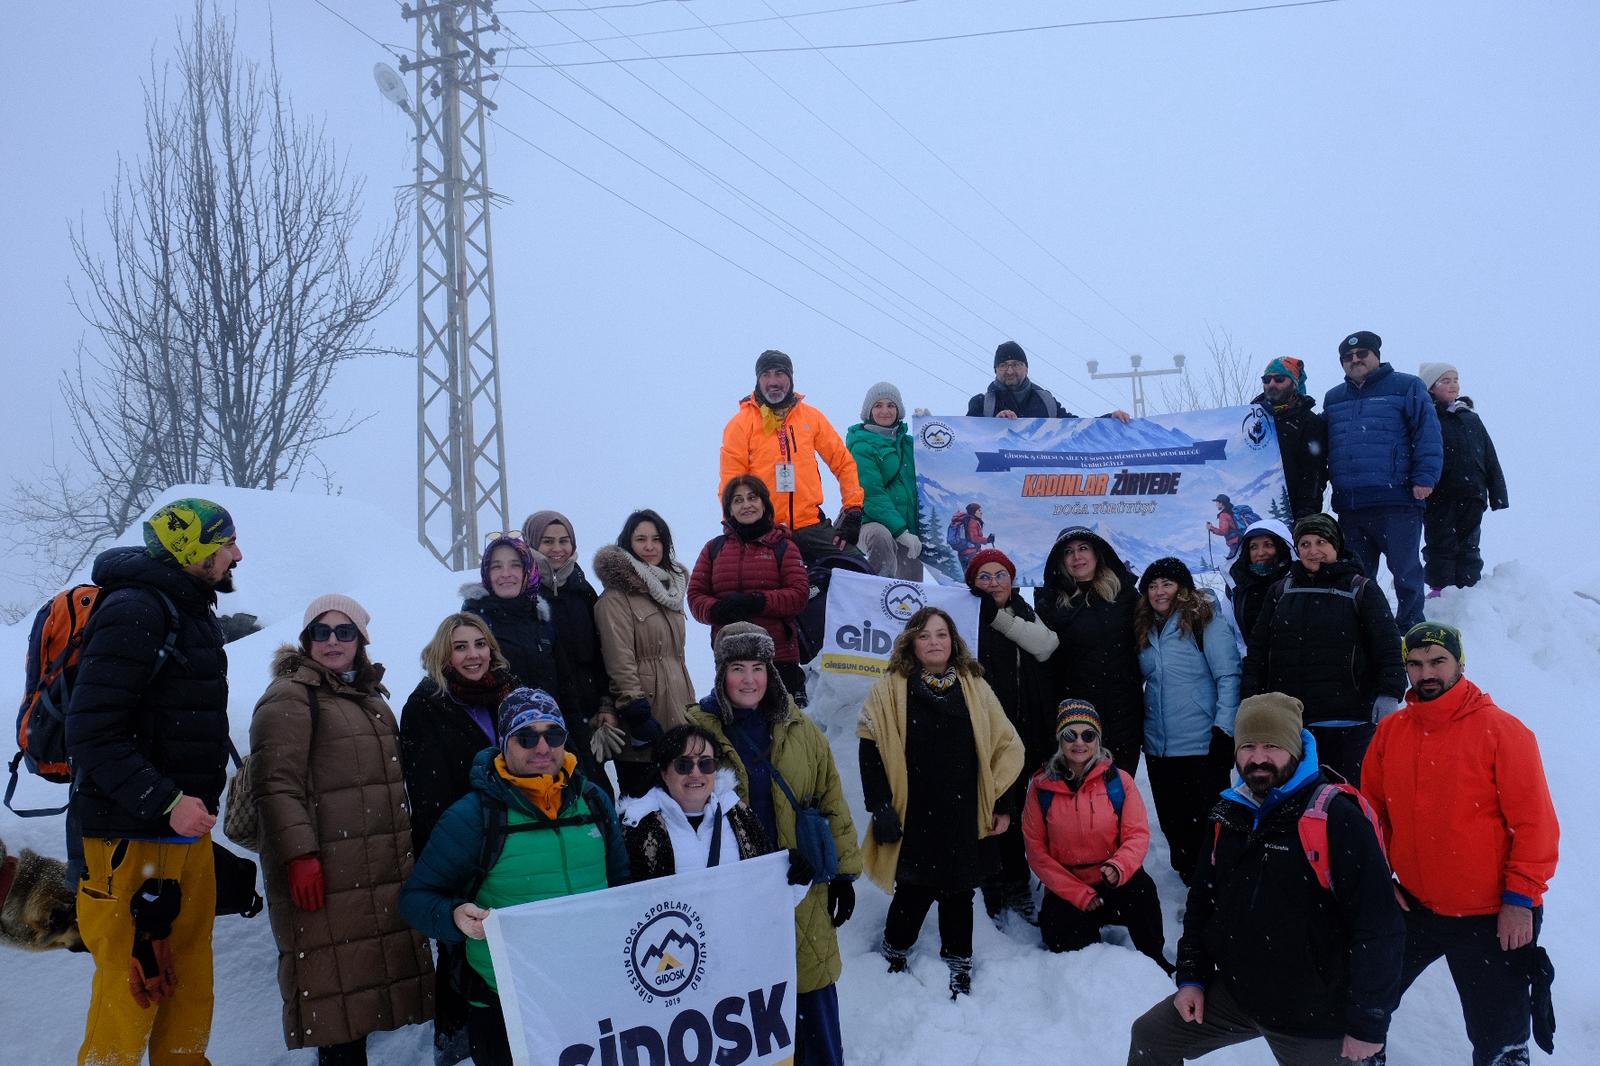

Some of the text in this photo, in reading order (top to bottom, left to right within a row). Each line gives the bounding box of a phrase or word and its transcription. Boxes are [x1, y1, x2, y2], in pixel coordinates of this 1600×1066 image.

[1022, 469, 1181, 497] KADINLAR ZİRVEDE
[1053, 500, 1158, 515] DOĞA YÜRÜYÜŞÜ
[836, 620, 897, 655] GİD
[824, 661, 857, 670] GİRESUN
[645, 901, 692, 920] SPORLARI
[690, 911, 705, 939] SPOR
[665, 997, 680, 1007] 2019
